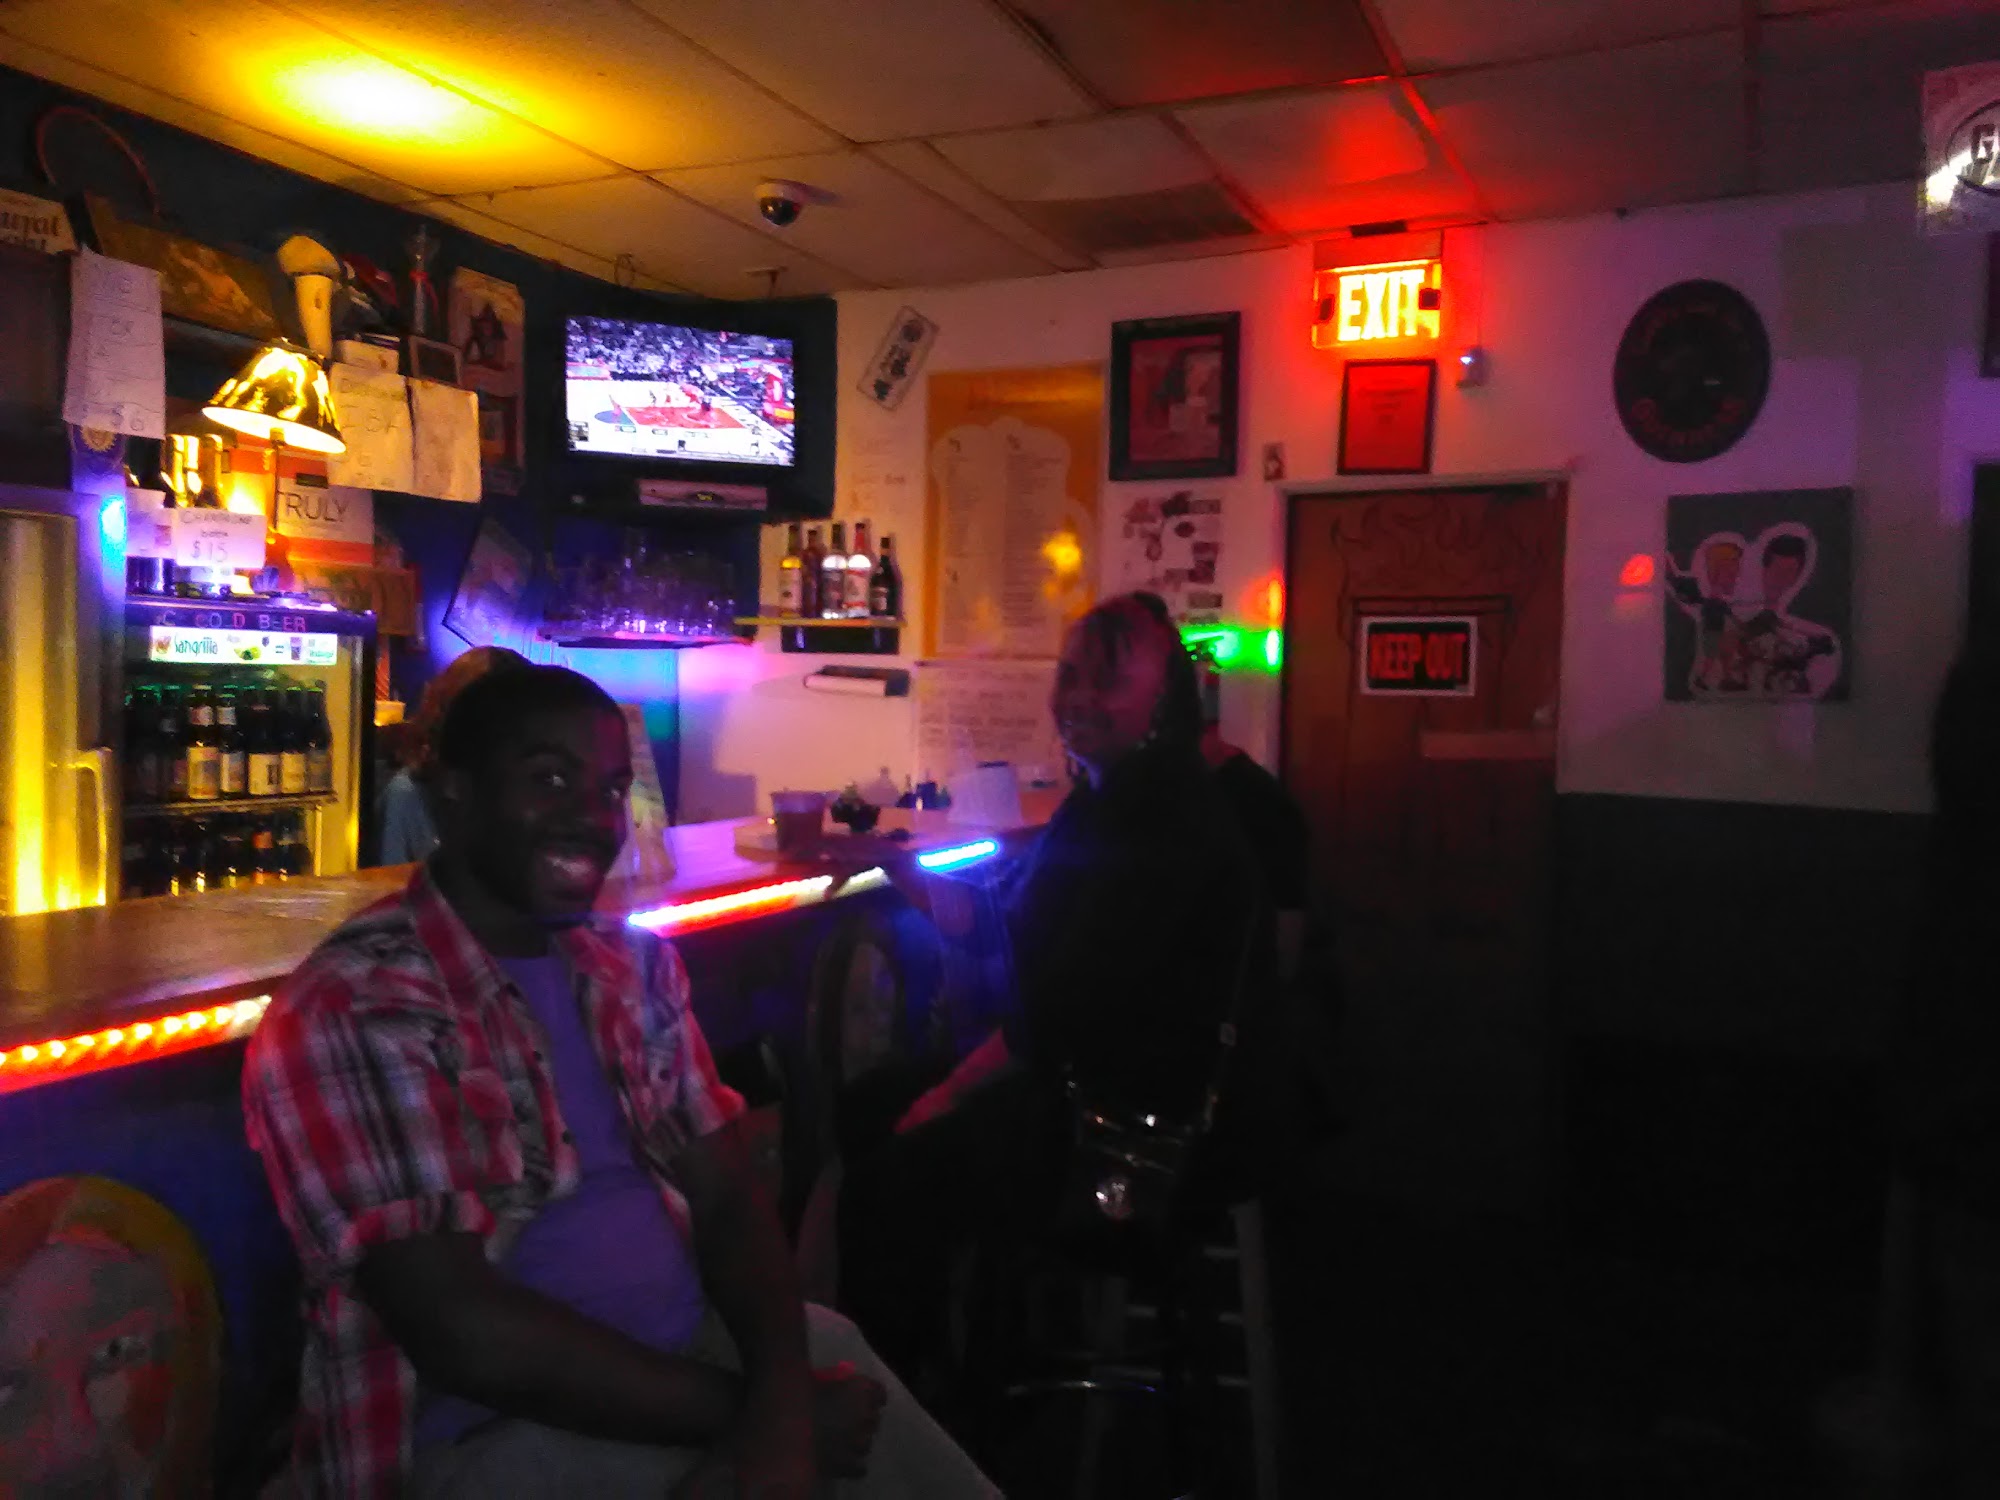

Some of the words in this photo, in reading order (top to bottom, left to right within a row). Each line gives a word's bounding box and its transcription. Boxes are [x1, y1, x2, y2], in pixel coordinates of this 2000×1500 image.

[1338, 269, 1424, 341] EXIT
[1370, 632, 1422, 680] KEEP
[1425, 632, 1467, 680] OUT
